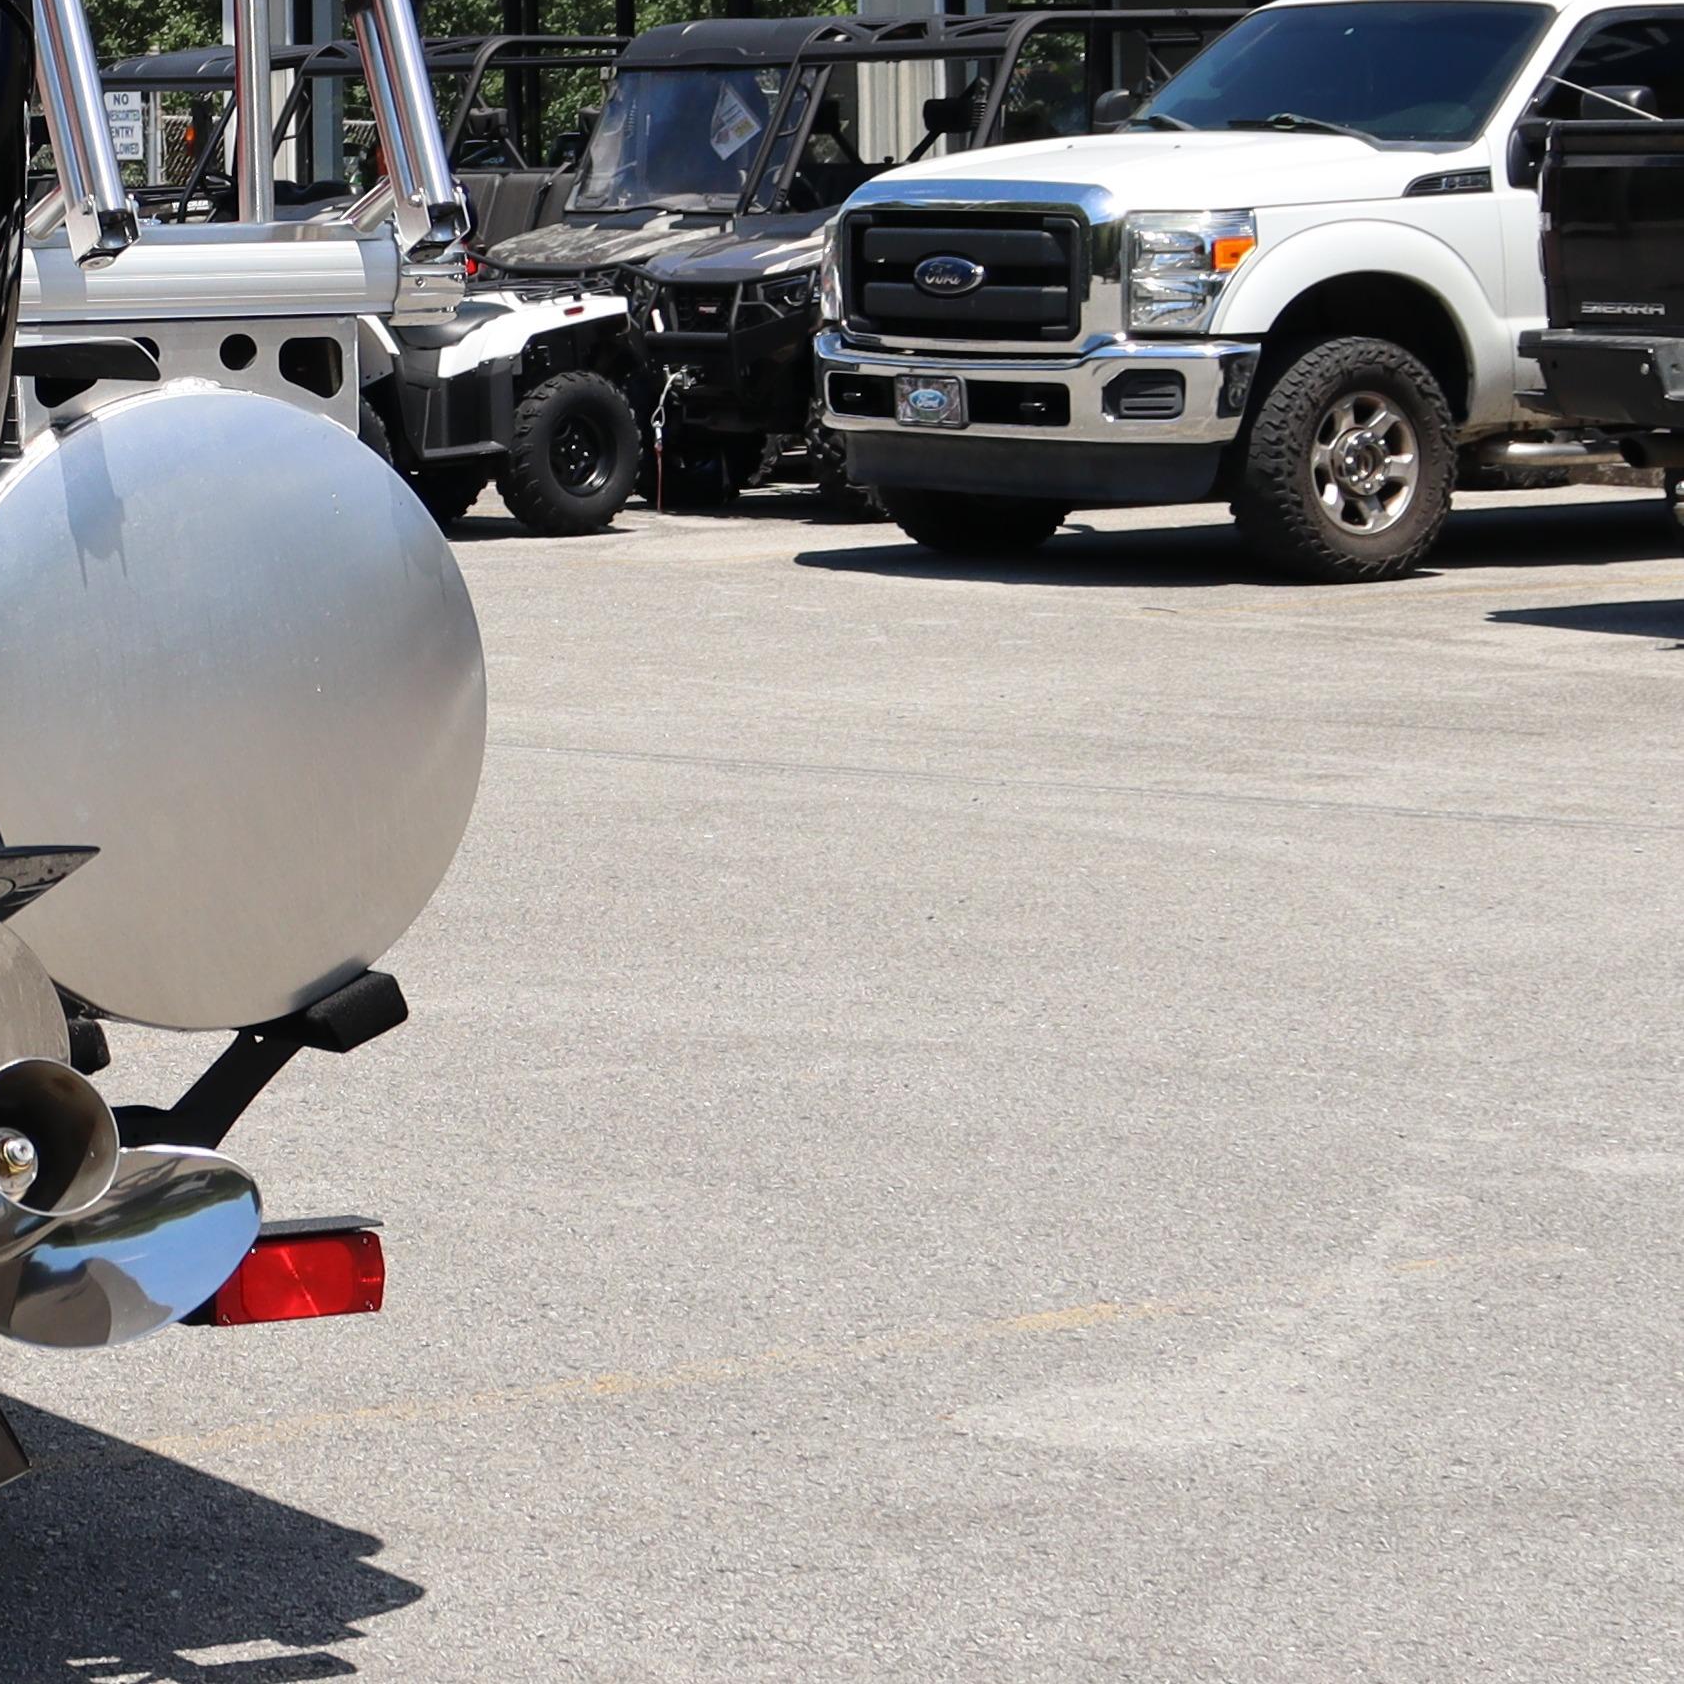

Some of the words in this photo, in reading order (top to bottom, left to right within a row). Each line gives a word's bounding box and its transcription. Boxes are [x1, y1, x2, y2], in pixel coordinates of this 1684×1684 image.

[113, 93, 129, 105] NO
[115, 142, 140, 154] LOWED
[1581, 301, 1666, 315] SIERRA
